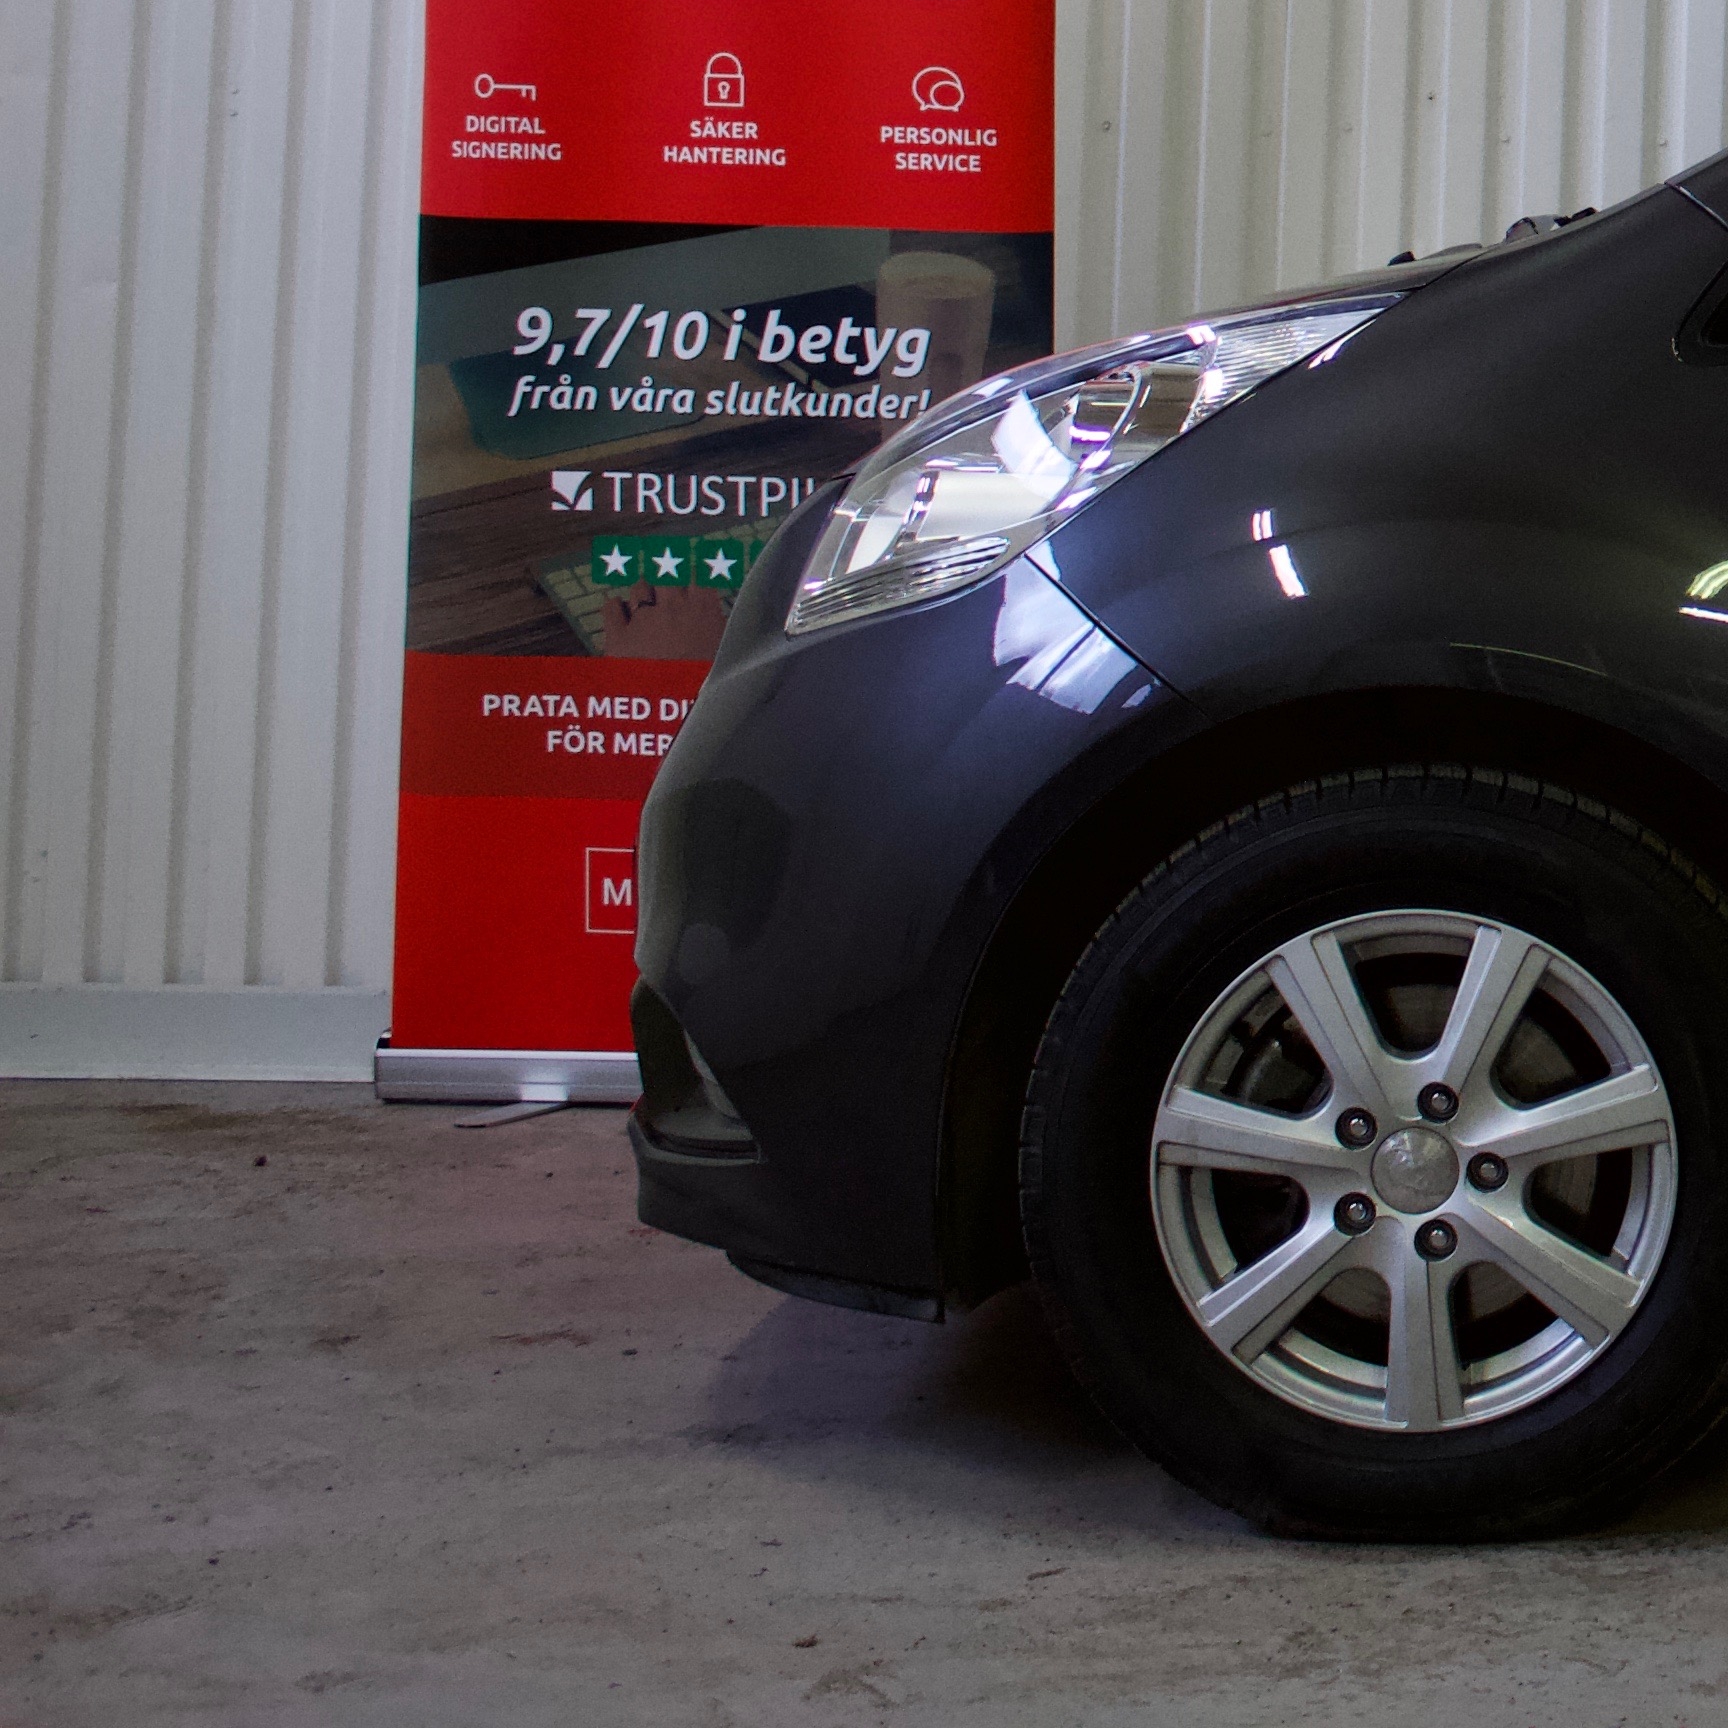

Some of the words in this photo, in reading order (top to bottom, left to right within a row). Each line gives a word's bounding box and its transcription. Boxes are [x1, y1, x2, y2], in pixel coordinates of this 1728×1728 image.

[465, 114, 546, 135] DIGITAL
[689, 116, 758, 140] SÄKER
[880, 125, 997, 147] PERSONLIG
[451, 140, 562, 161] SIGNERING
[663, 145, 787, 166] HANTERING
[895, 152, 982, 173] SERVICE
[513, 303, 709, 369] 9,7/10
[722, 308, 746, 361] i
[757, 309, 929, 378] betyg
[507, 373, 597, 417] från
[610, 375, 695, 414] våra
[703, 380, 932, 419] slutkunder!
[482, 694, 580, 718] PRATA
[587, 695, 652, 721] MED
[659, 698, 695, 722] DI
[547, 724, 606, 754] FÖR
